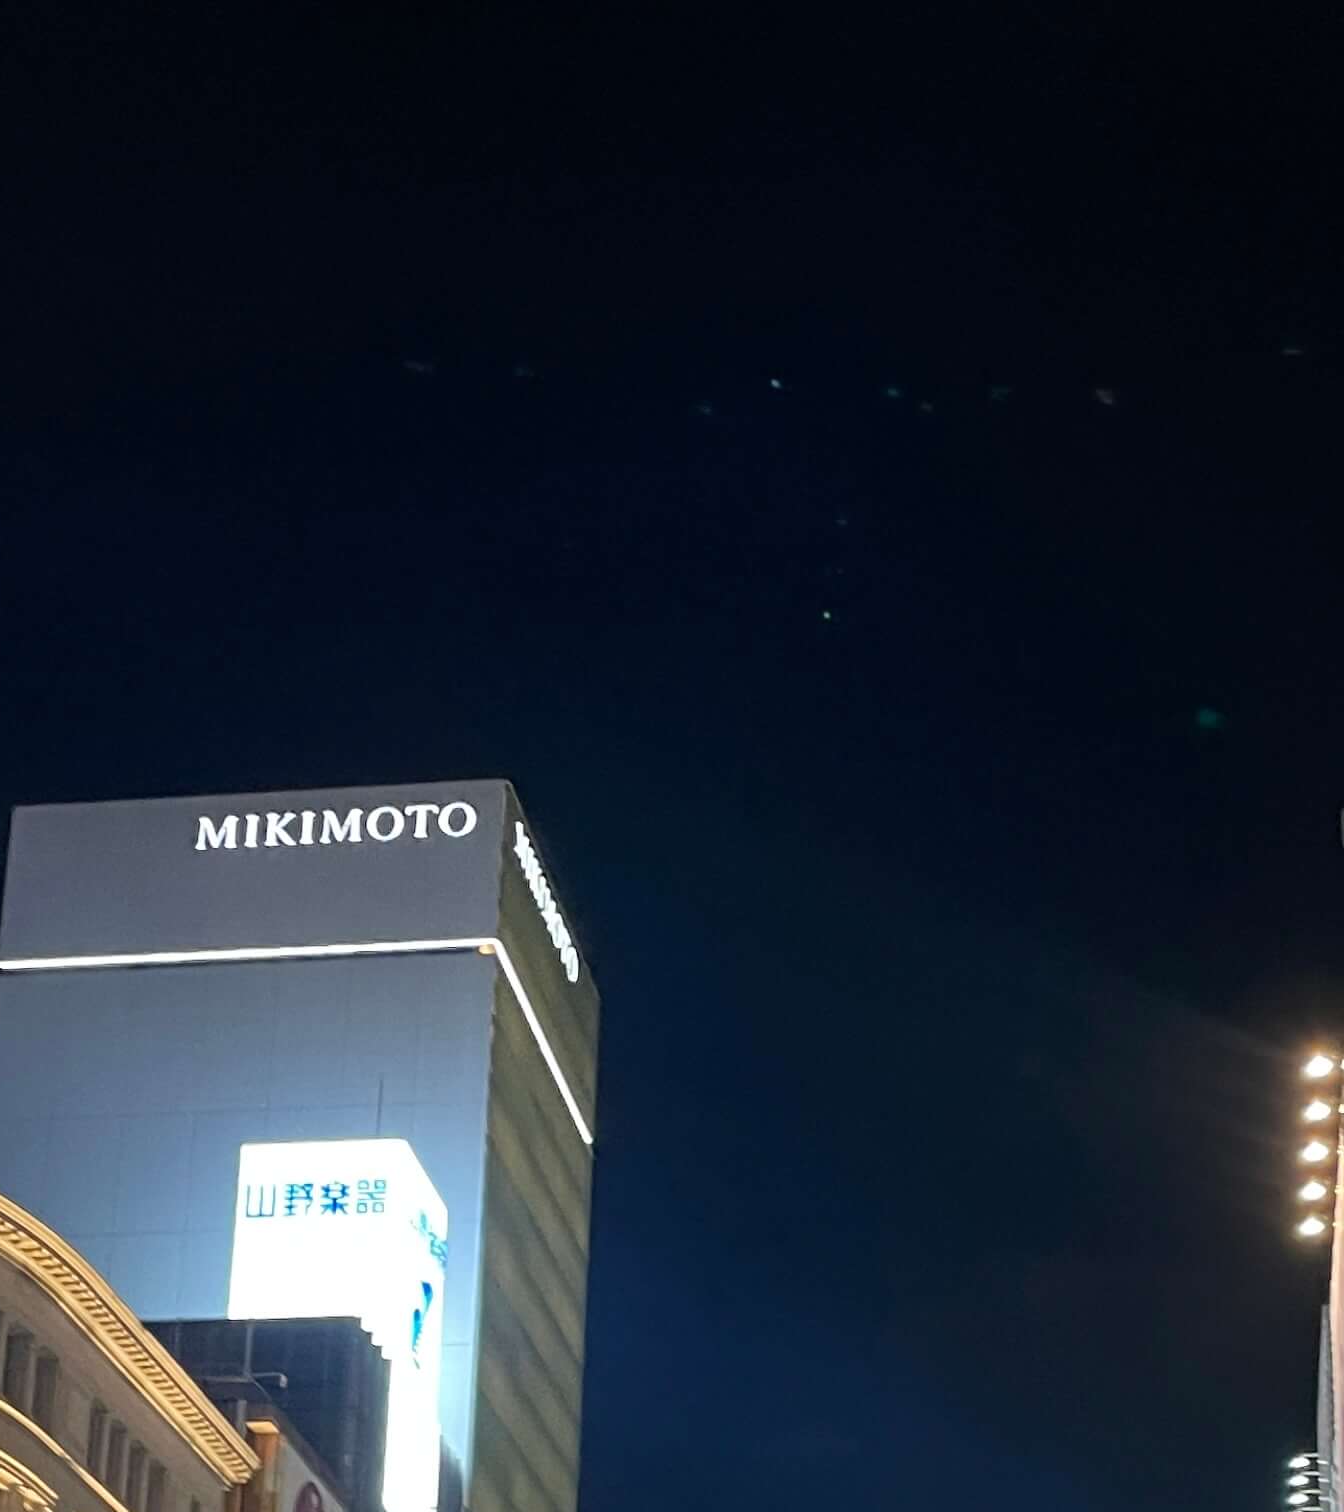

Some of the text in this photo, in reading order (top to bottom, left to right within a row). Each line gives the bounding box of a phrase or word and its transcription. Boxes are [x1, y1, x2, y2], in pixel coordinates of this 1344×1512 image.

[194, 801, 478, 851] MIKIMOTO
[244, 1177, 387, 1219] 山野楽器
